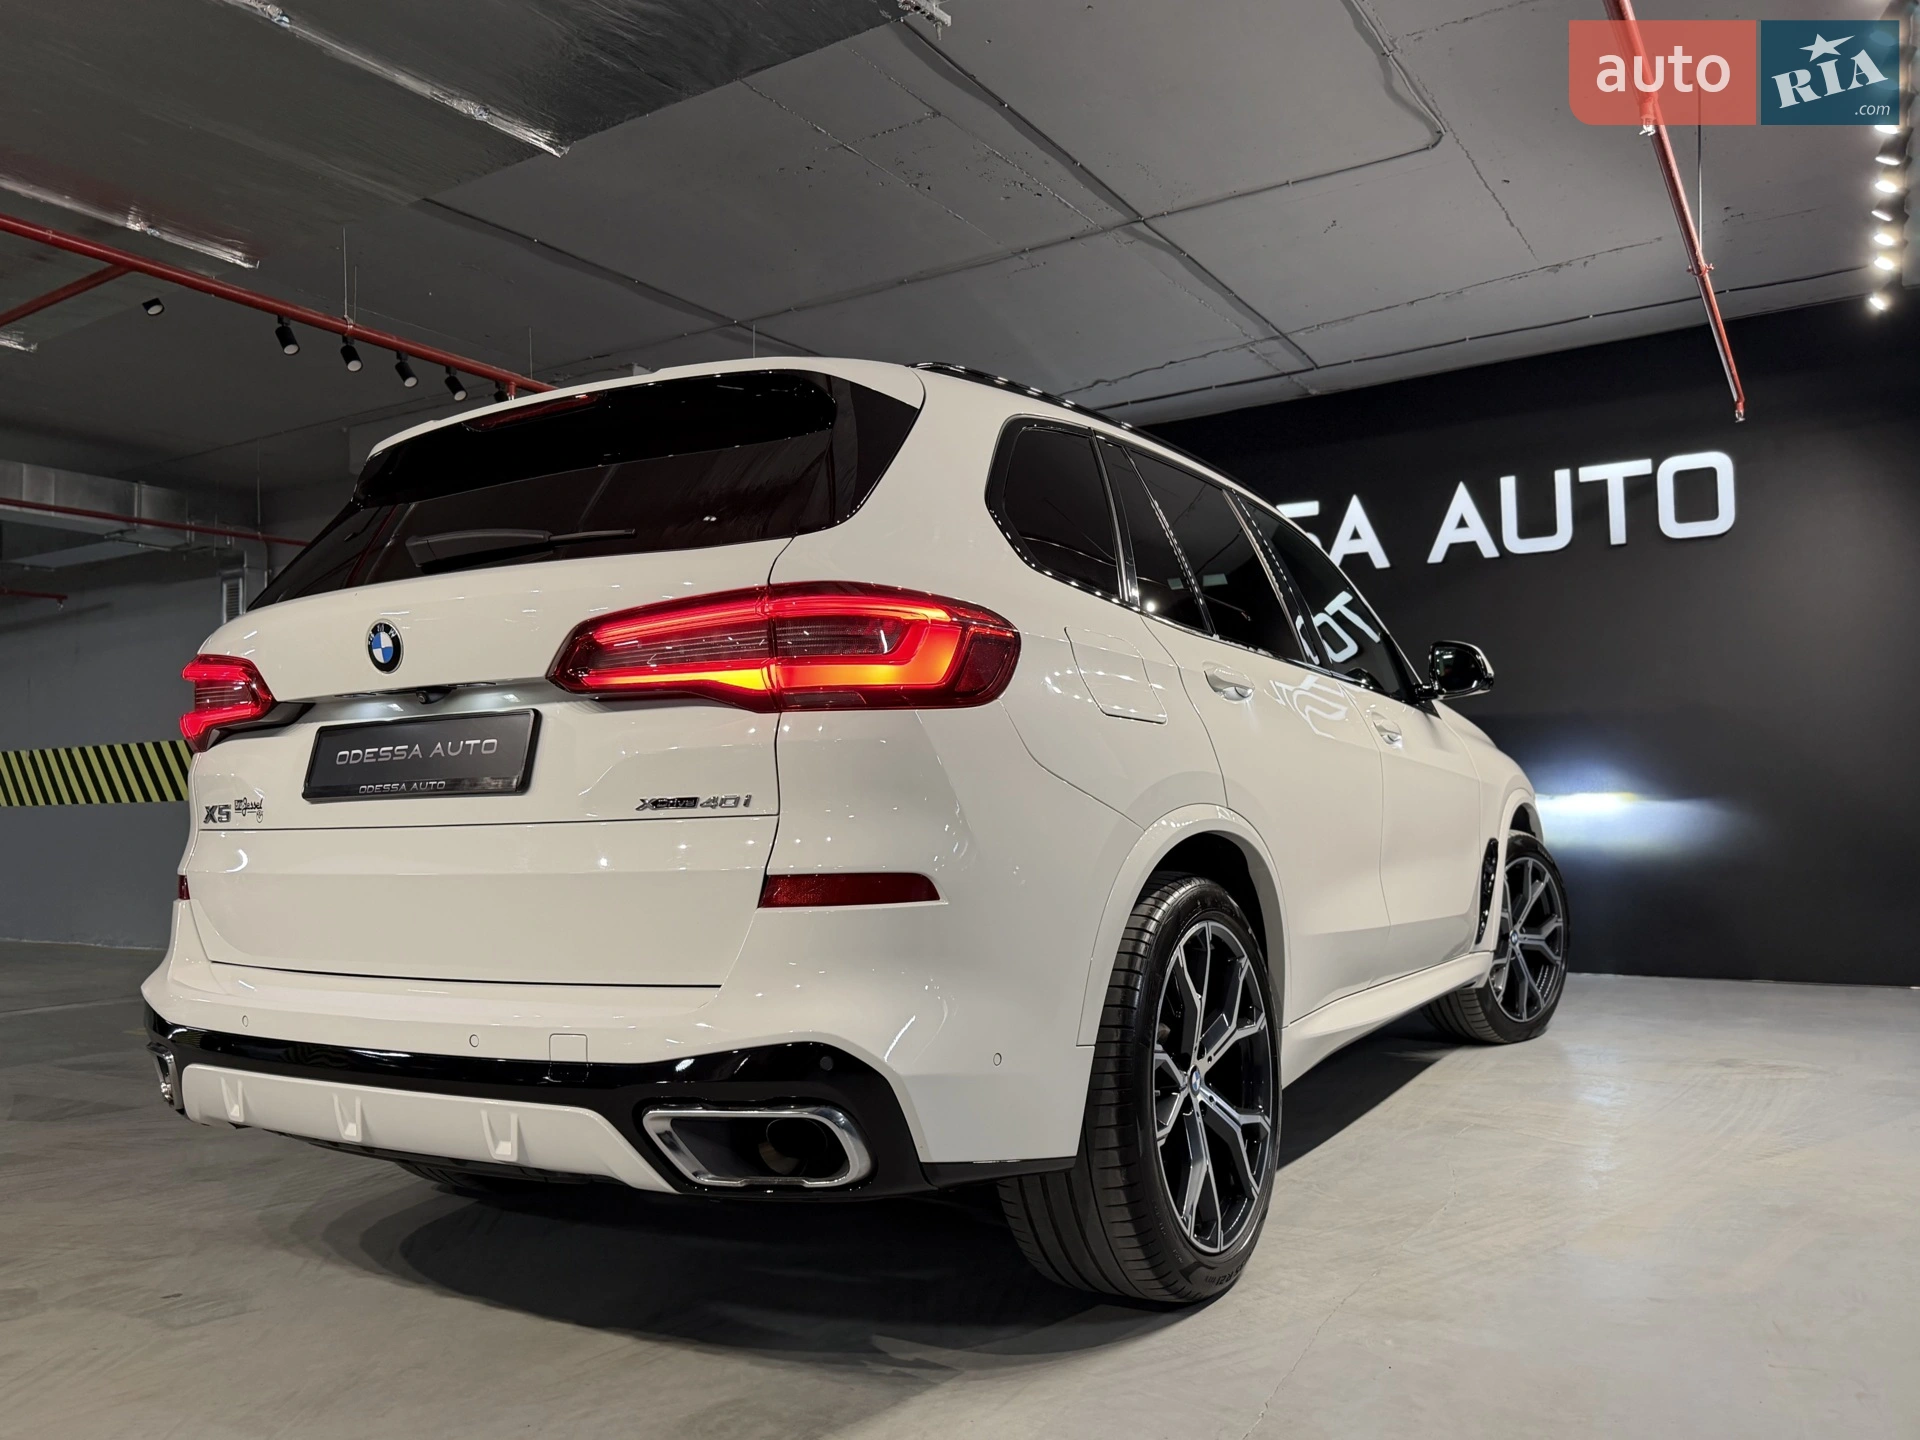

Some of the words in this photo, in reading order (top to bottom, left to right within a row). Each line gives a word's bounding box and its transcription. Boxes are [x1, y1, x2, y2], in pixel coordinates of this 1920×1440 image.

[1427, 450, 1736, 564] AUTO
[336, 743, 423, 765] ODESSA
[429, 738, 498, 758] AUTO
[359, 783, 407, 794] ODESSA
[410, 781, 446, 791] AUTO
[203, 804, 232, 824] X5
